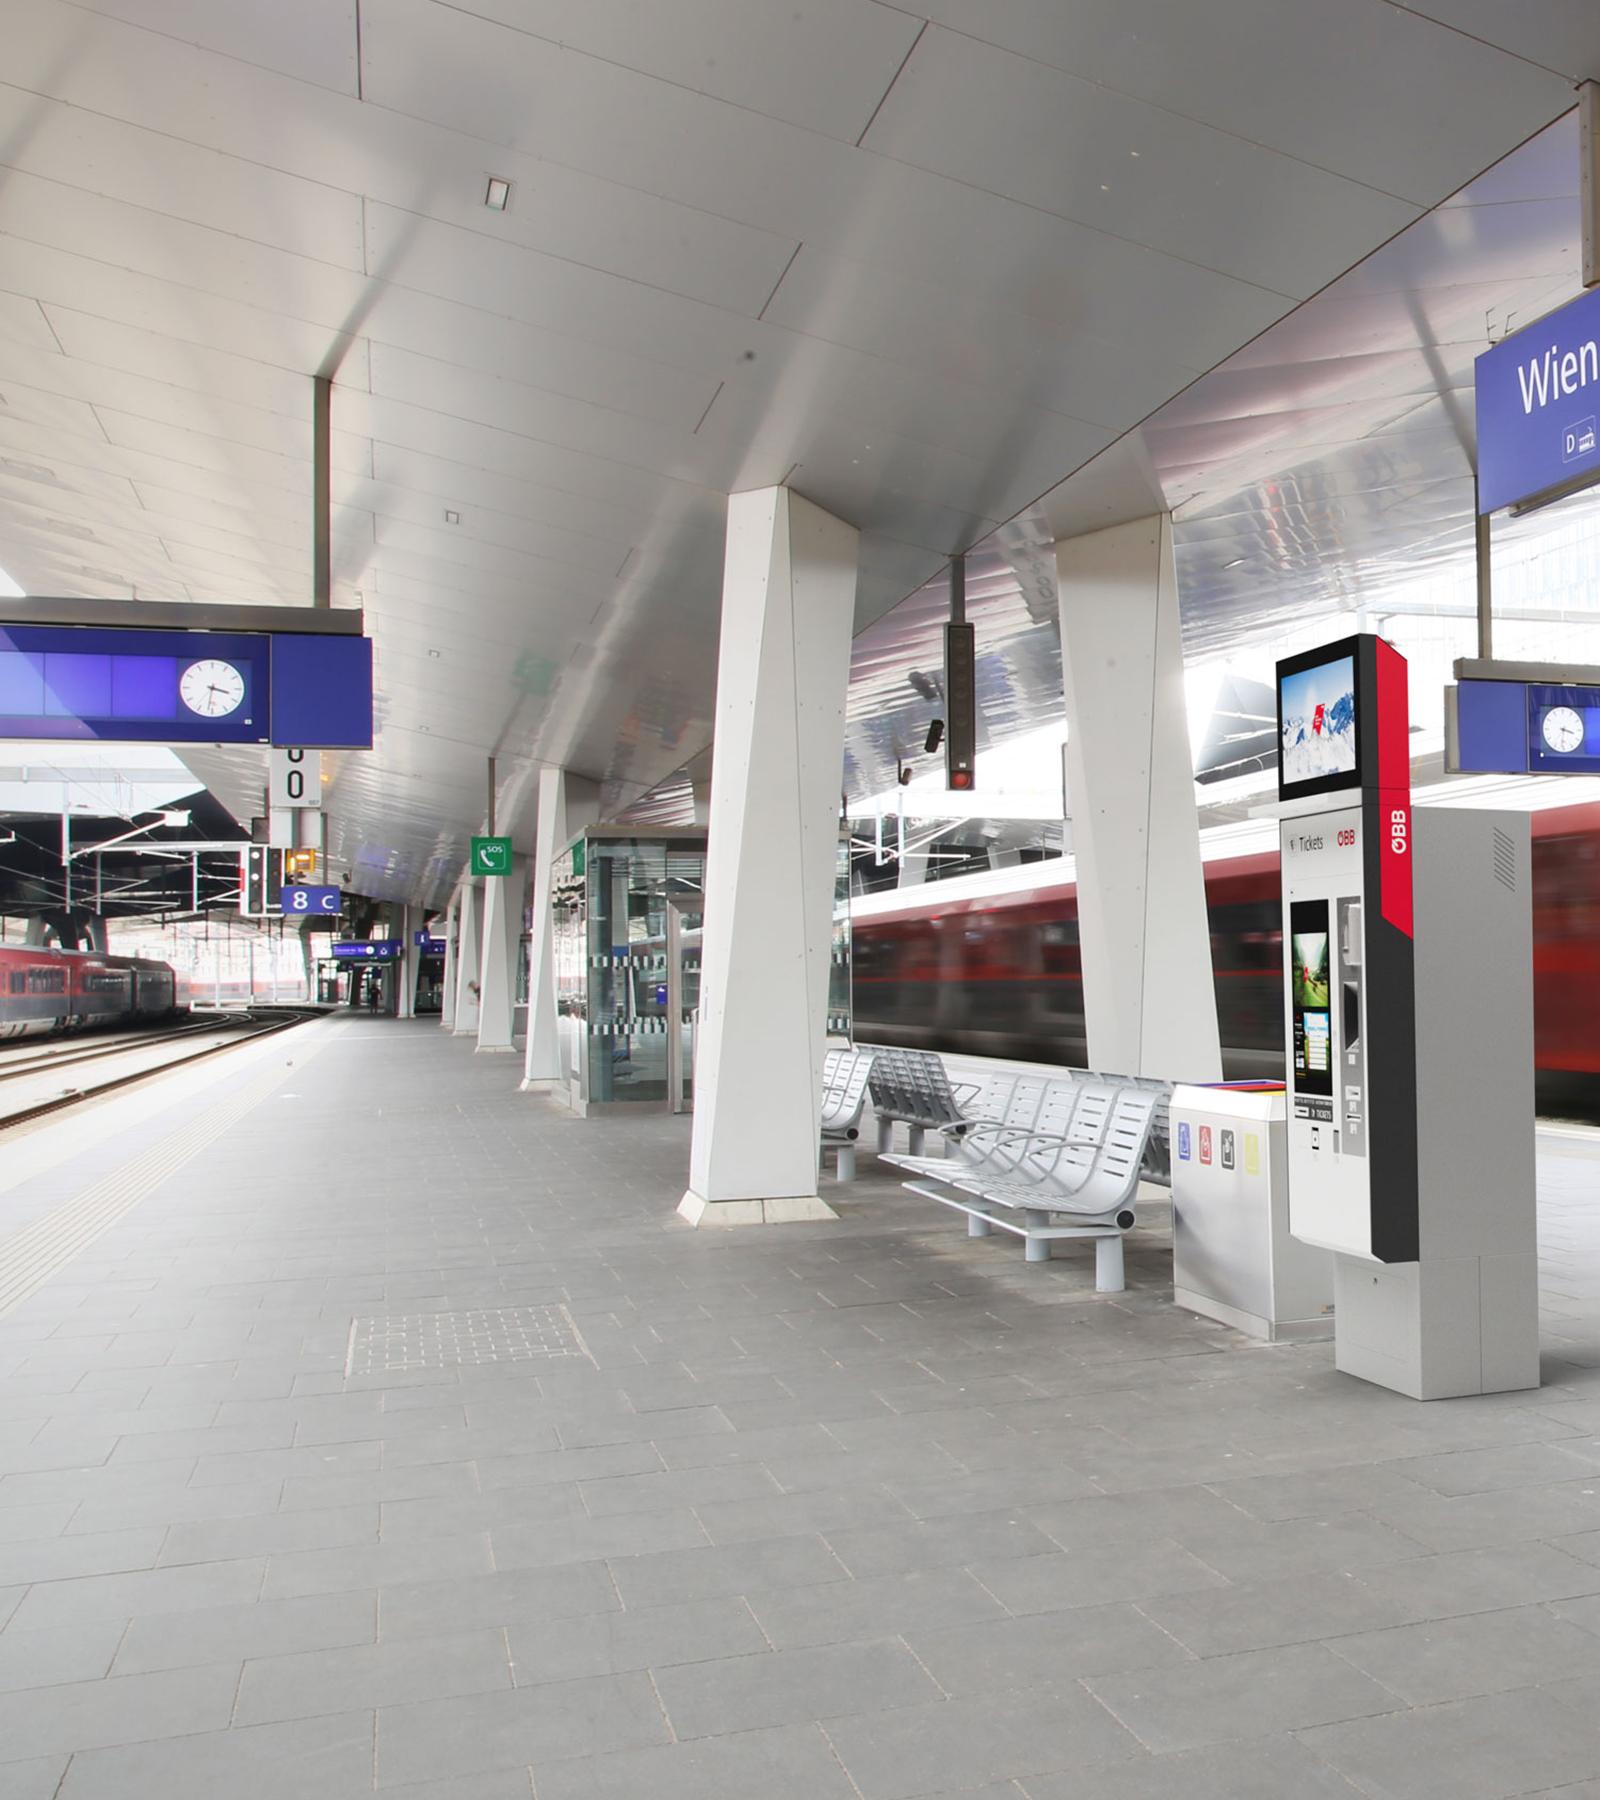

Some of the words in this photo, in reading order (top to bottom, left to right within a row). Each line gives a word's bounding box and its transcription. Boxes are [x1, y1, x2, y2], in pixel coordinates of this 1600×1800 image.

[1518, 341, 1598, 414] Wien
[1566, 434, 1575, 454] D
[1299, 835, 1323, 852] Tickets
[1337, 829, 1355, 846] ÖBB
[1391, 810, 1407, 854] ÖBB
[486, 845, 503, 853] SOS
[293, 891, 308, 909] 8
